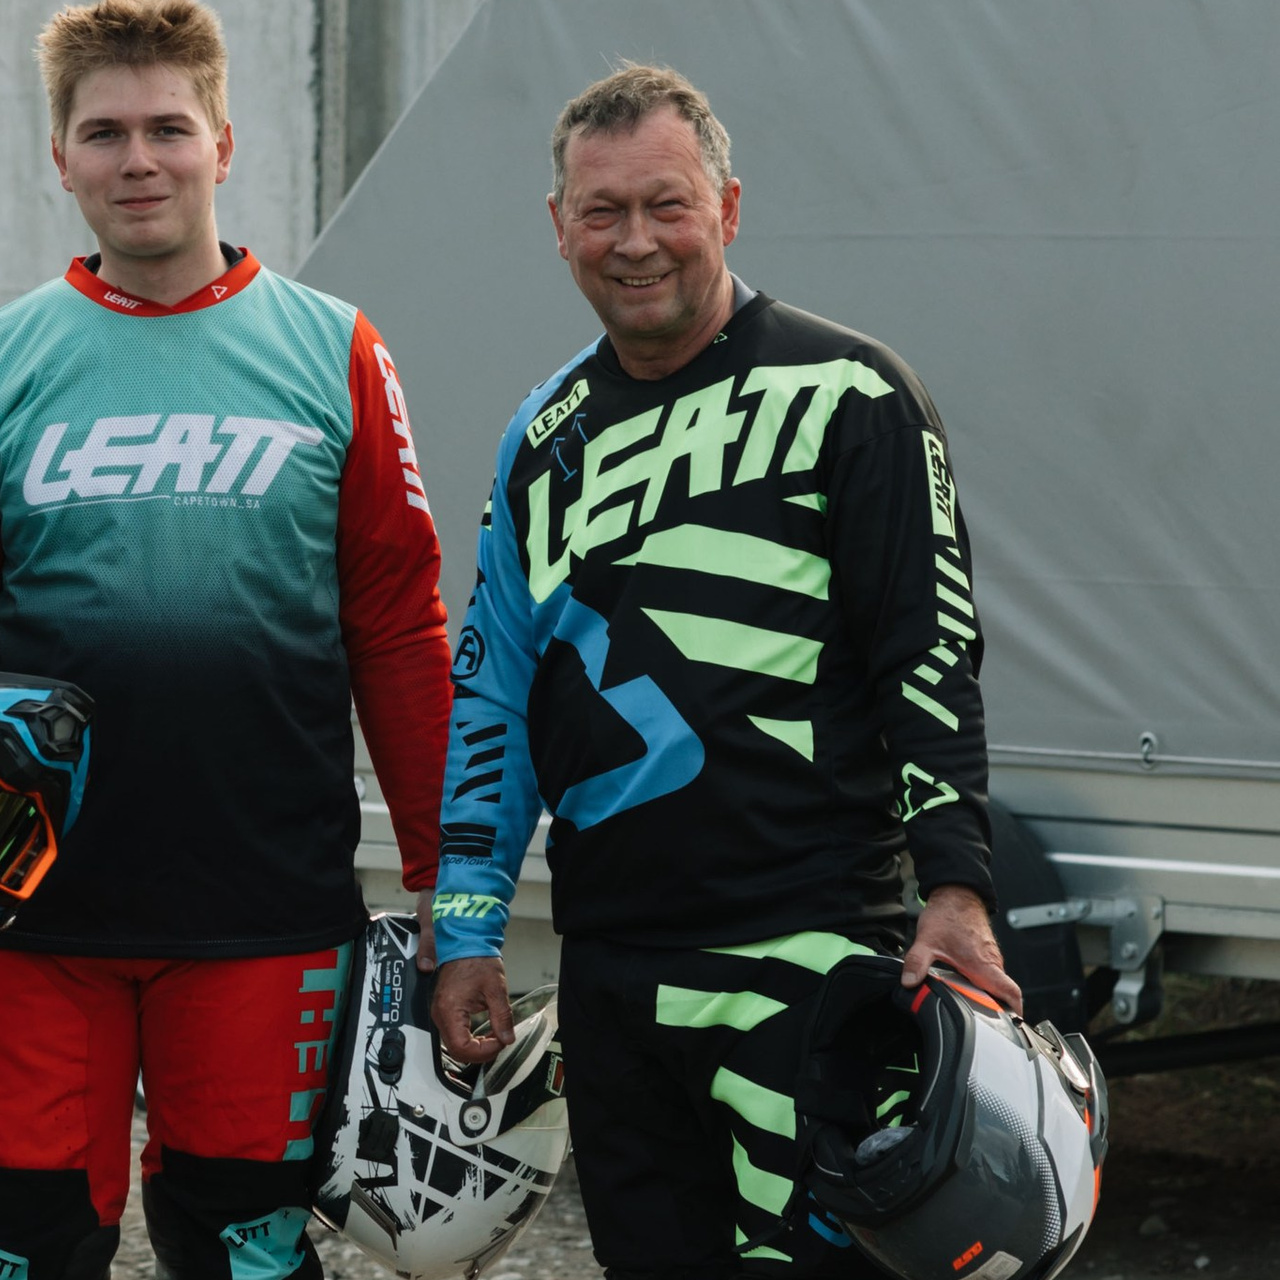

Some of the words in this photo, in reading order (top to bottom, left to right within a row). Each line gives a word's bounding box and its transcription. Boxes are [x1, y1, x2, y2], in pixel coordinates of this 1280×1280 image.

[104, 291, 142, 309] LEATT
[532, 385, 580, 439] LEATT
[23, 414, 325, 506] LEATT
[527, 358, 895, 603] LEATT
[928, 439, 954, 532] LEATT
[432, 894, 501, 923] EATT
